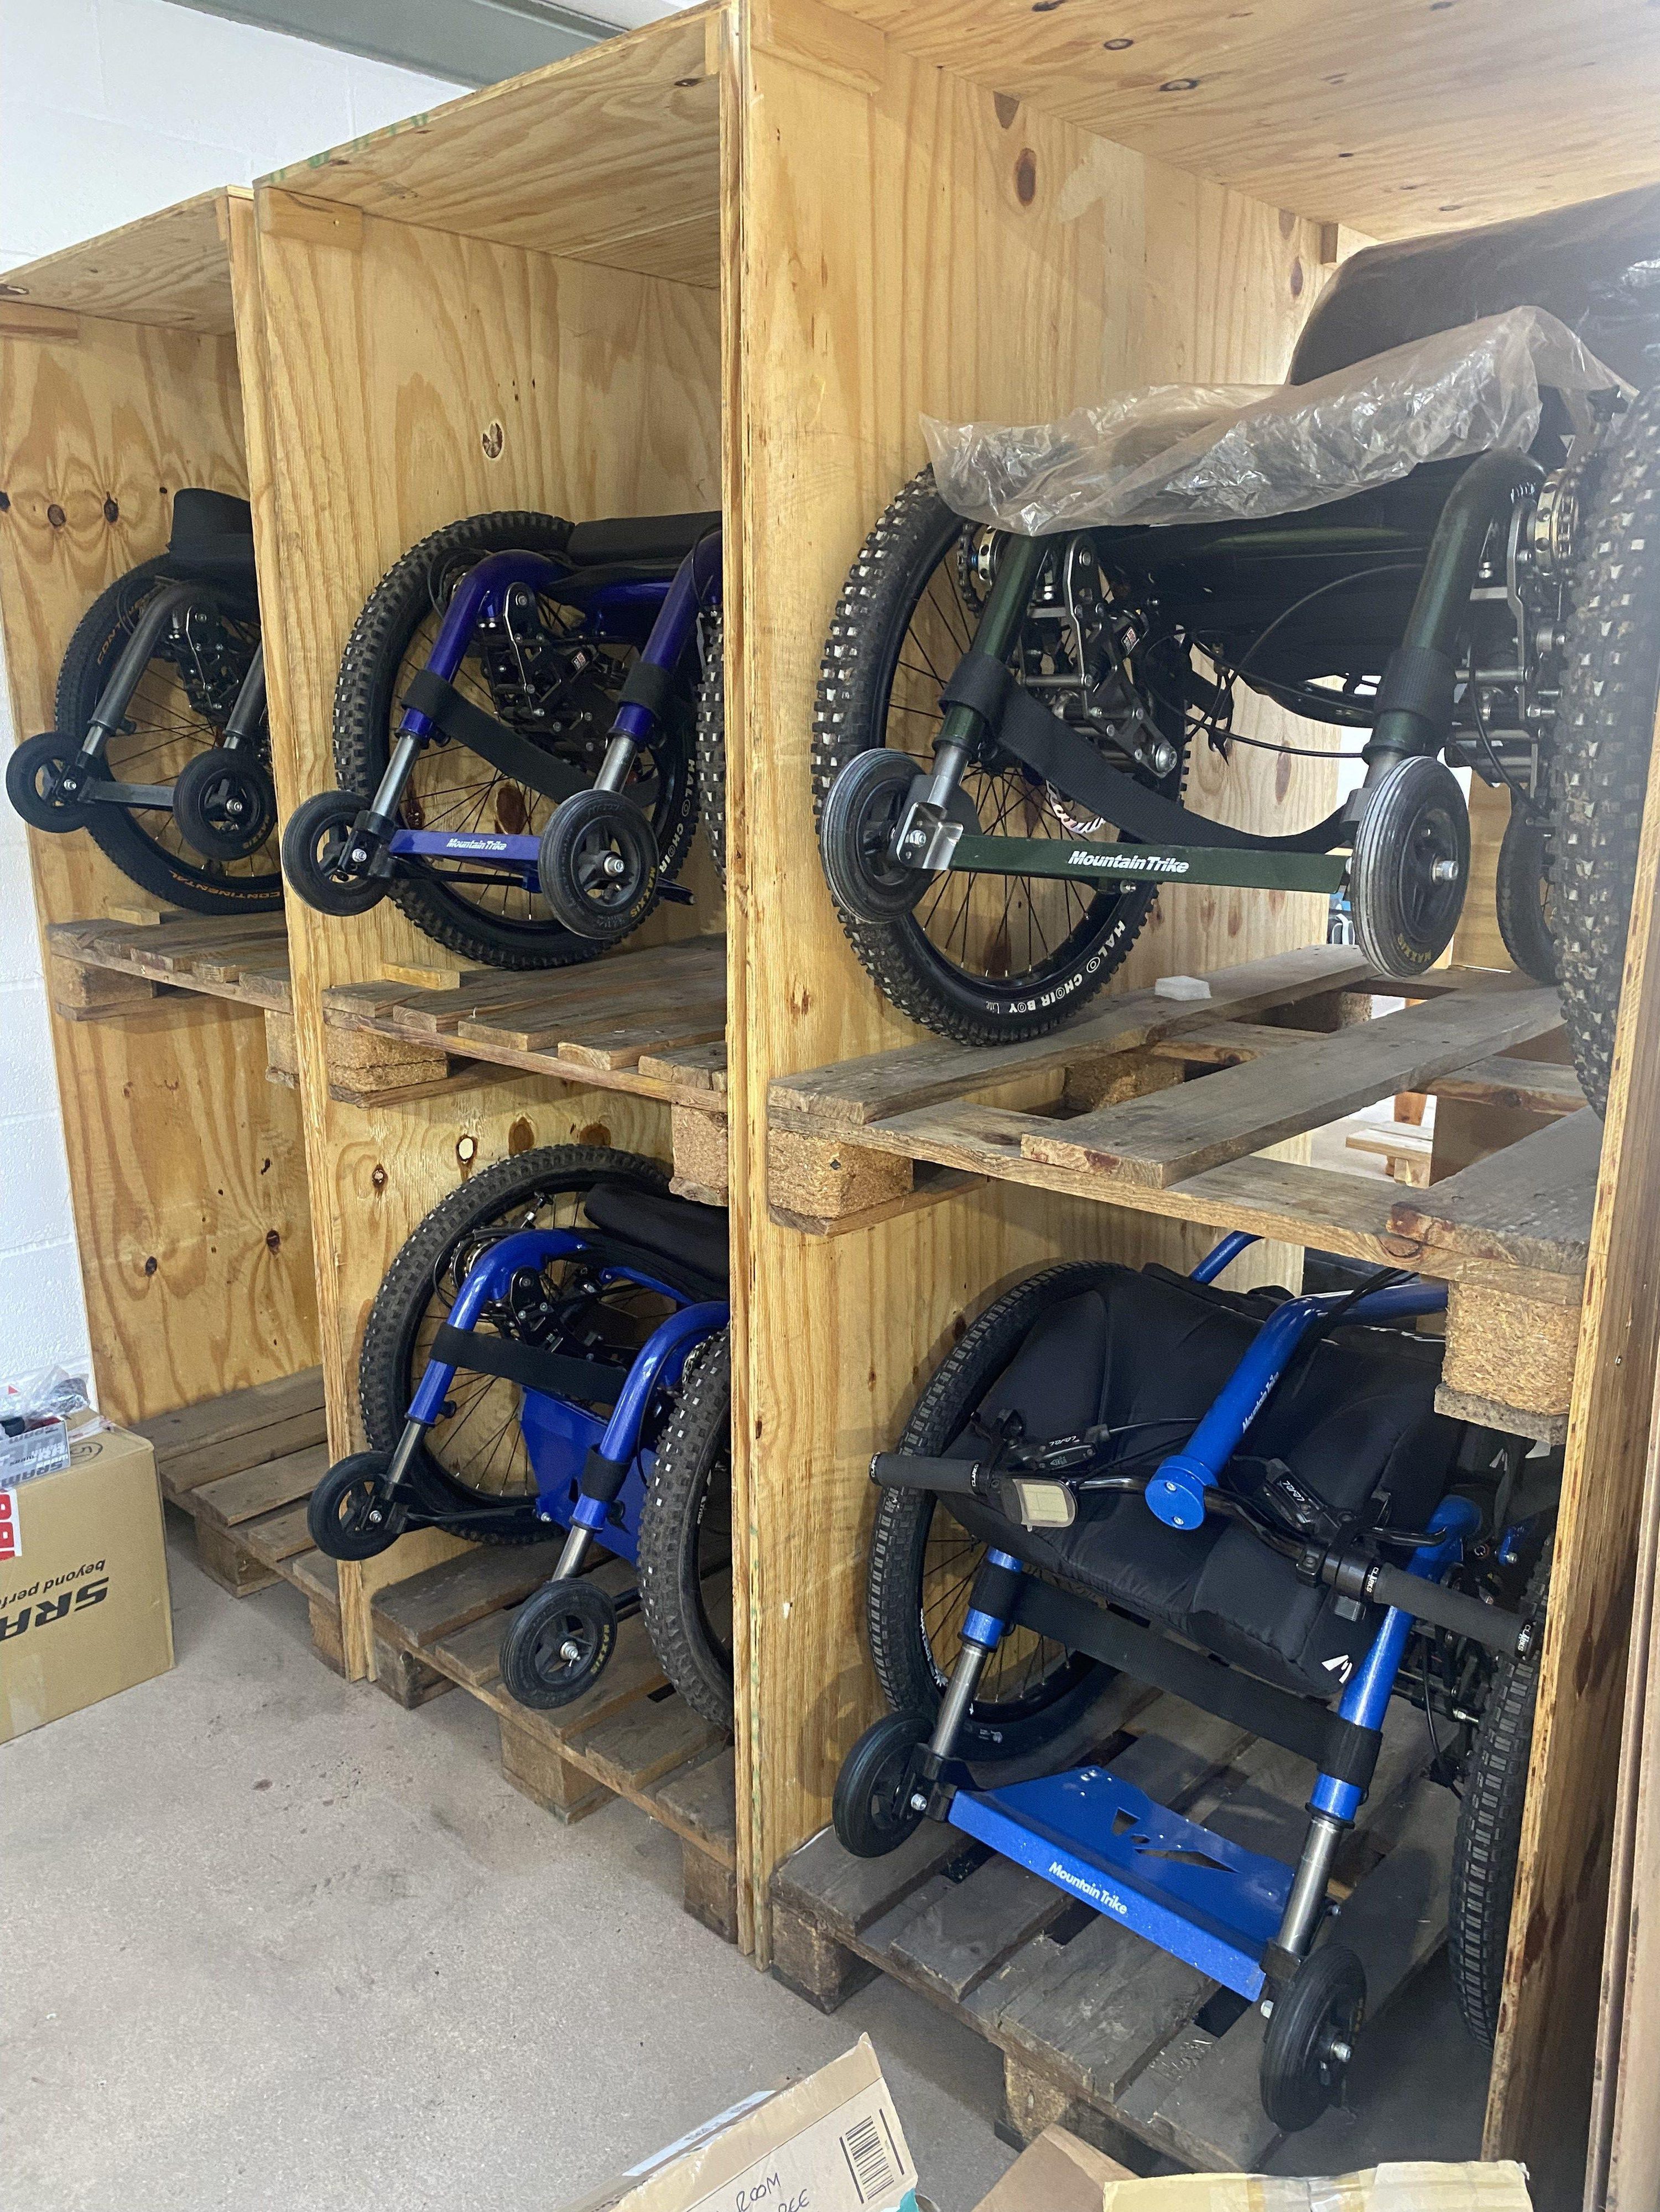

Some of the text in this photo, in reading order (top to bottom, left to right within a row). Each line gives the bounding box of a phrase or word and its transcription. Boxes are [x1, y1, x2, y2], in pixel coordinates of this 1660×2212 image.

[659, 758, 695, 873] HALO CHOIR
[168, 869, 281, 899] CONTINENTAL
[629, 866, 656, 918] MAXXIS
[1086, 920, 1126, 973] HALO
[1008, 999, 1037, 1014] BOY
[1040, 973, 1083, 1007] CHOIR
[0, 1559, 106, 1609] beyond perf
[590, 1624, 610, 1674] MAXXIS
[1048, 1861, 1128, 1914] Mountain Trike
[736, 2172, 781, 2212] ROOM
